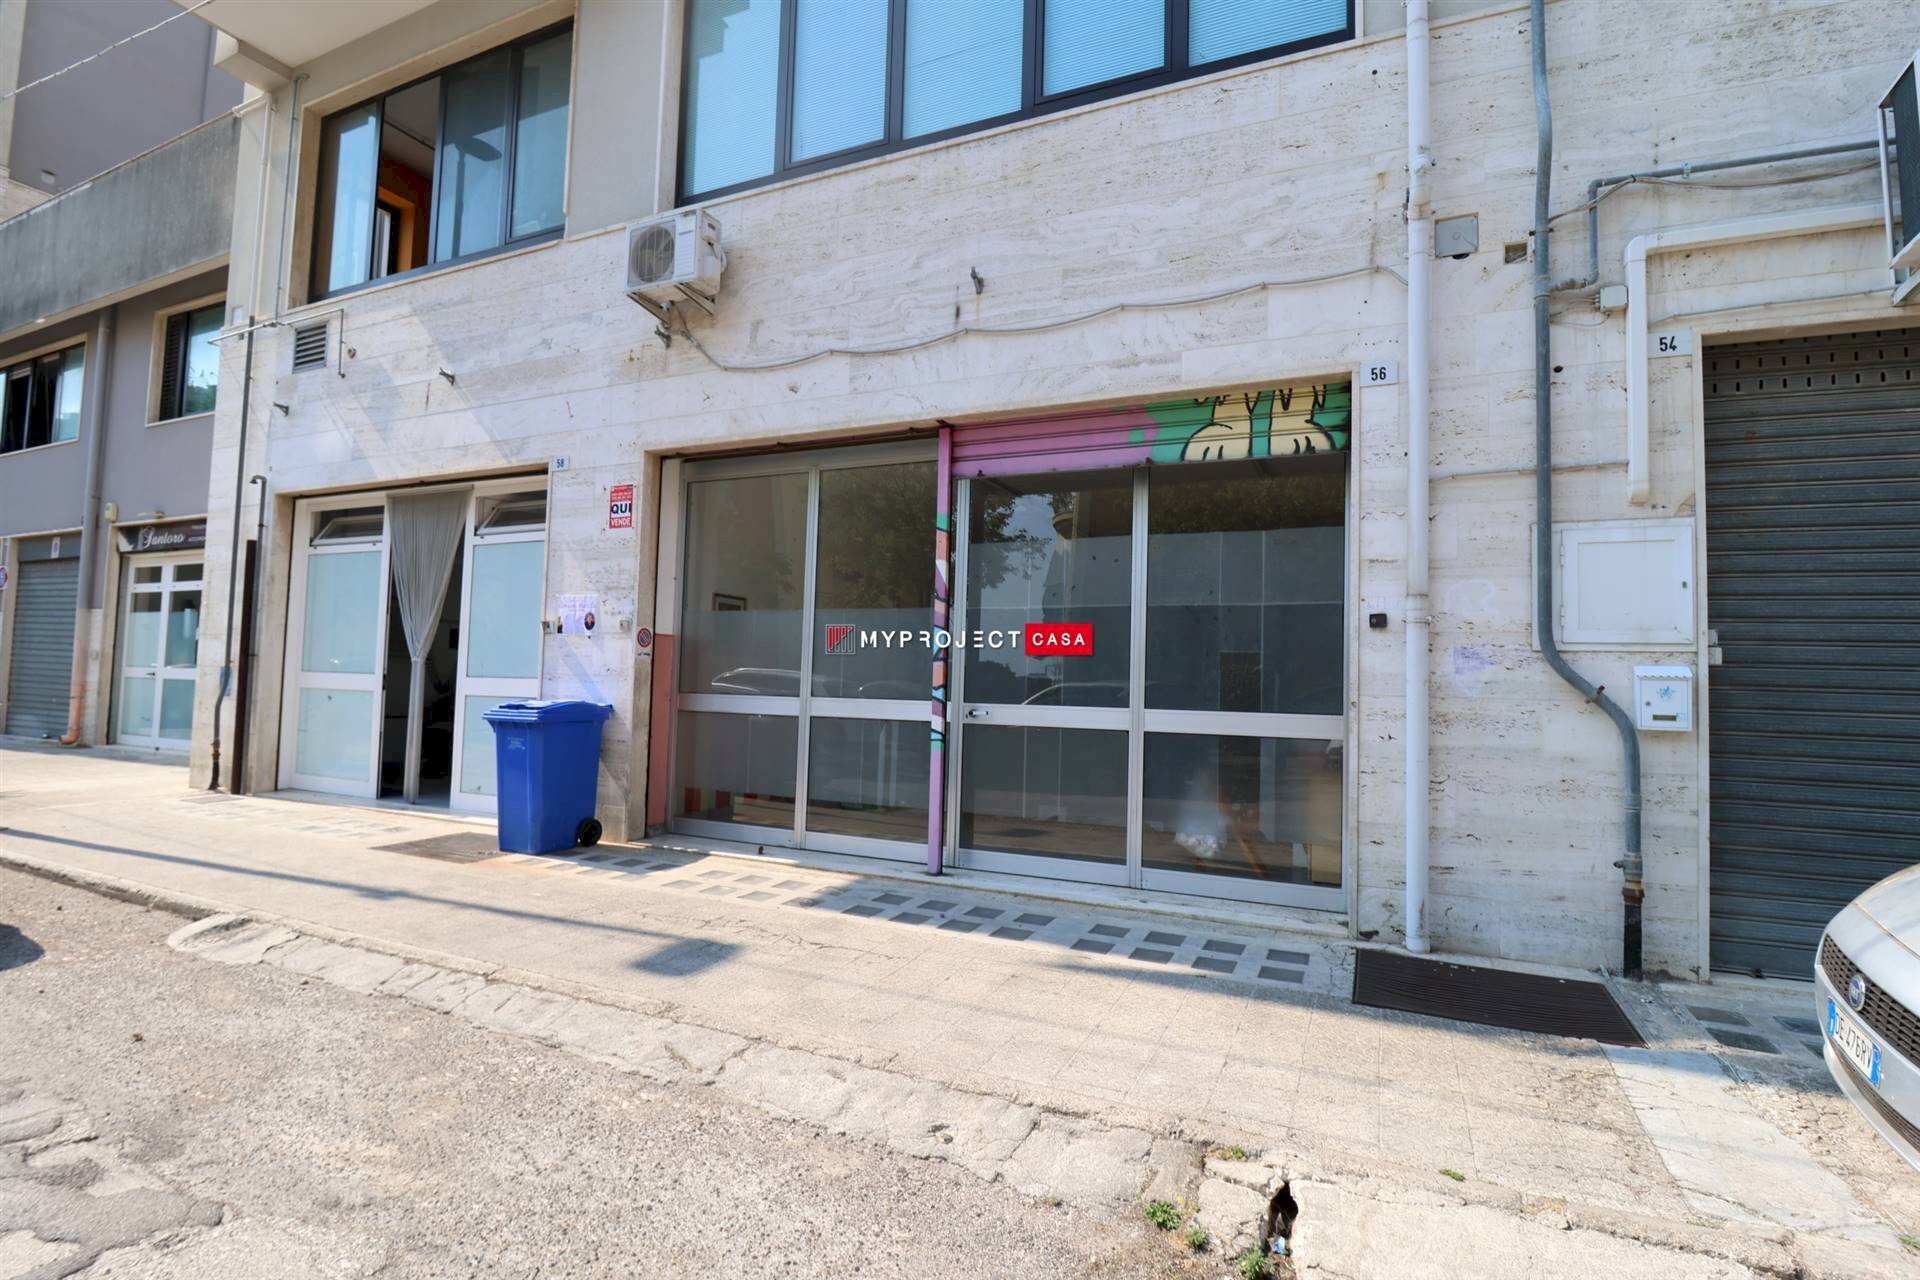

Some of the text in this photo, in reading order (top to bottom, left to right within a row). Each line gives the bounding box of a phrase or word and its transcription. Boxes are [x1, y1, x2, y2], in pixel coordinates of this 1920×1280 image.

[1659, 336, 1677, 352] 54
[1371, 366, 1386, 381] 56
[611, 503, 632, 514] QUI
[611, 517, 631, 527] VENDE
